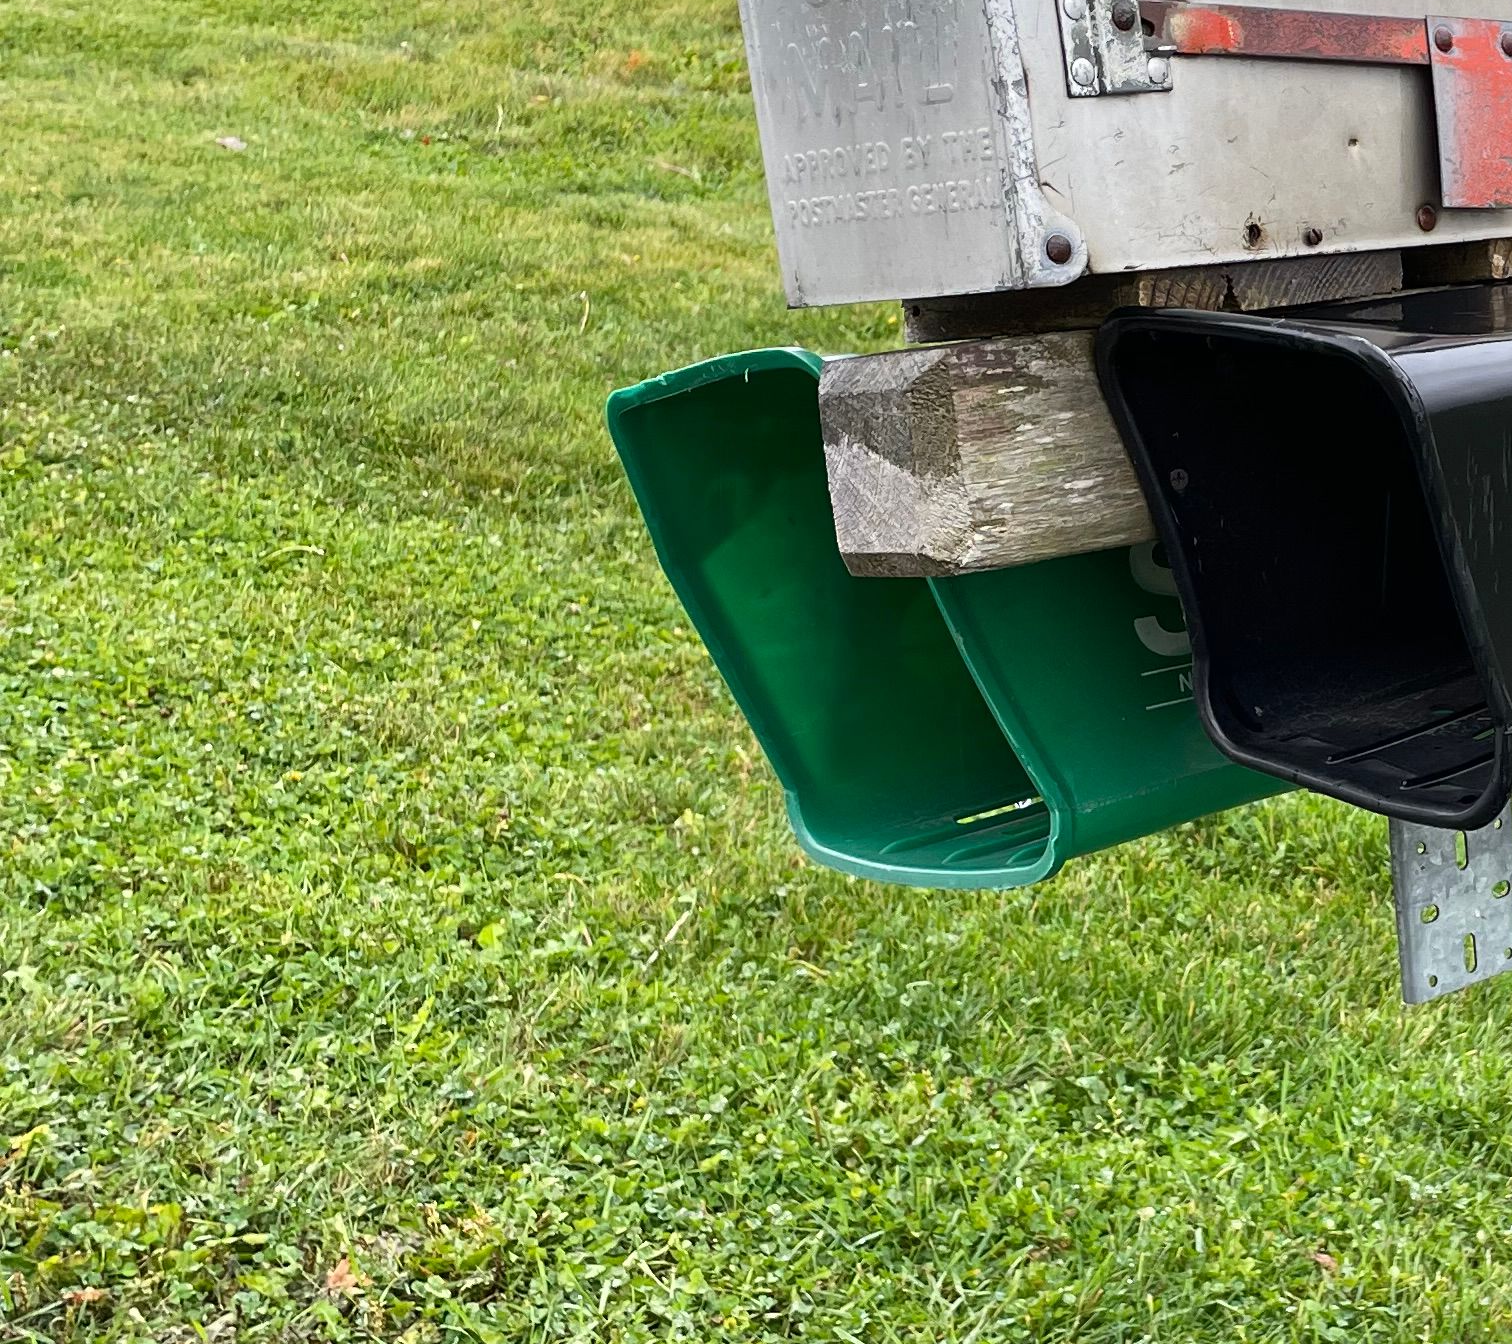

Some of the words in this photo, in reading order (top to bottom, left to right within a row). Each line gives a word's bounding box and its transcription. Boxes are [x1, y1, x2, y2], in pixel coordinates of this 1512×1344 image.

[783, 140, 892, 185] APPROVED
[900, 133, 933, 168] BY
[941, 127, 994, 164] THE
[786, 187, 902, 231] POSTMASTER
